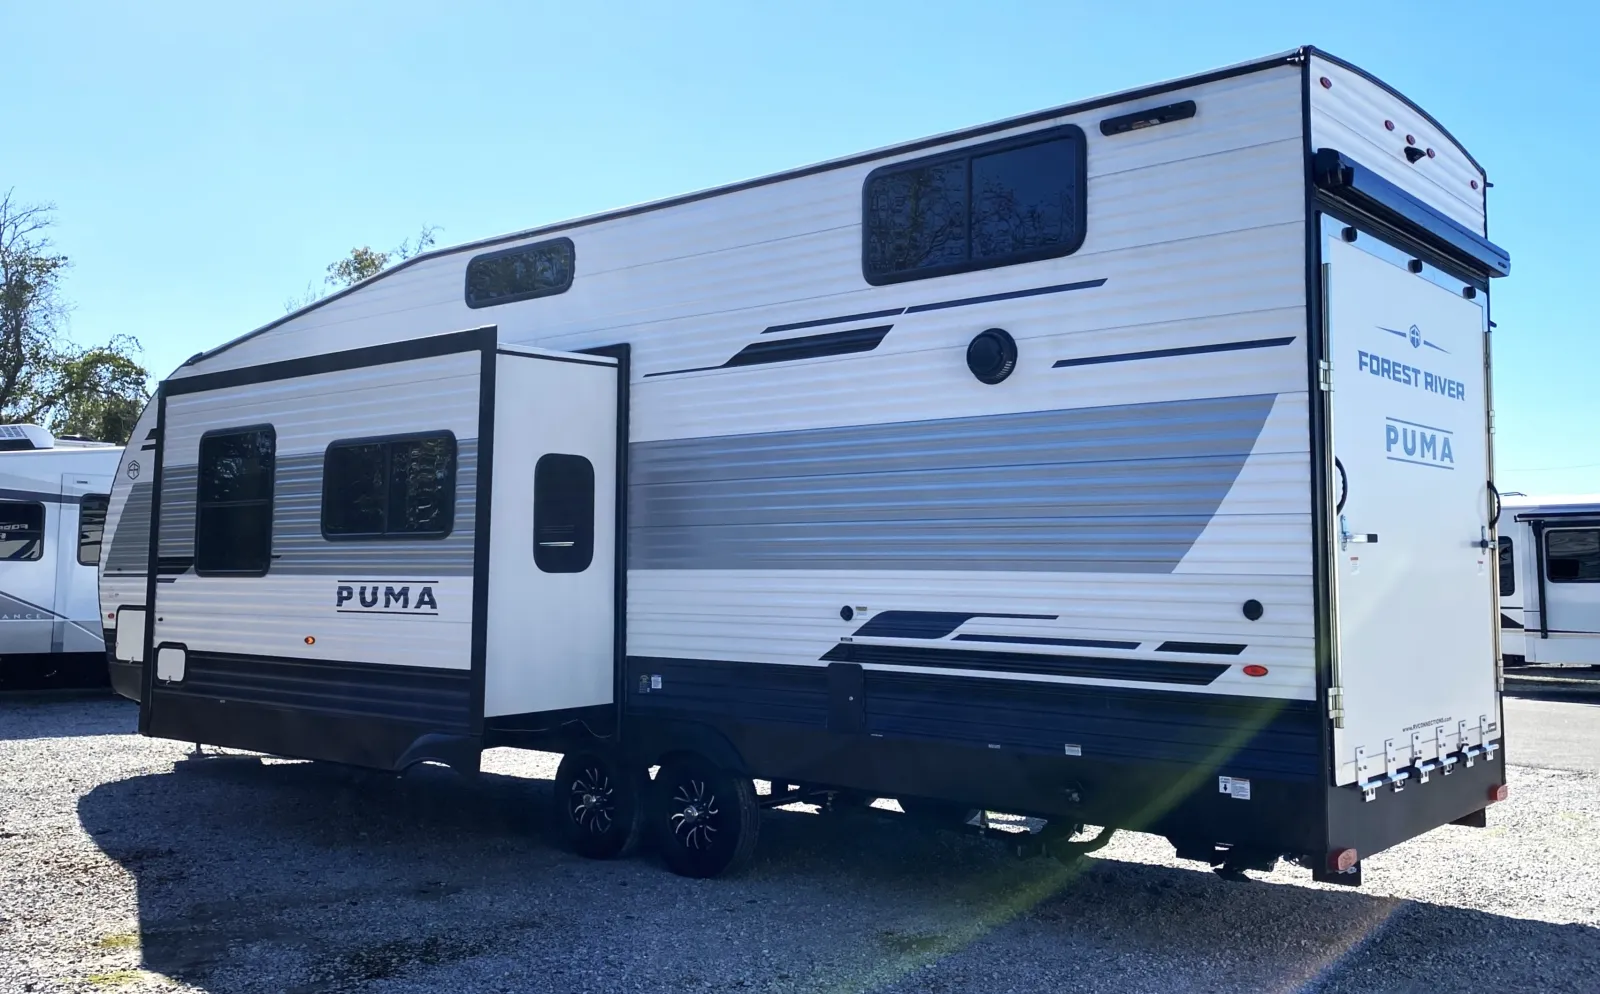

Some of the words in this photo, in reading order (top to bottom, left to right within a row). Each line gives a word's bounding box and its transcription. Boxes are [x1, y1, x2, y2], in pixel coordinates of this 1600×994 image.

[1357, 350, 1421, 388] FOREST
[1424, 371, 1465, 401] RIVER
[1385, 424, 1454, 463] PUMA
[336, 585, 438, 609] PUMA
